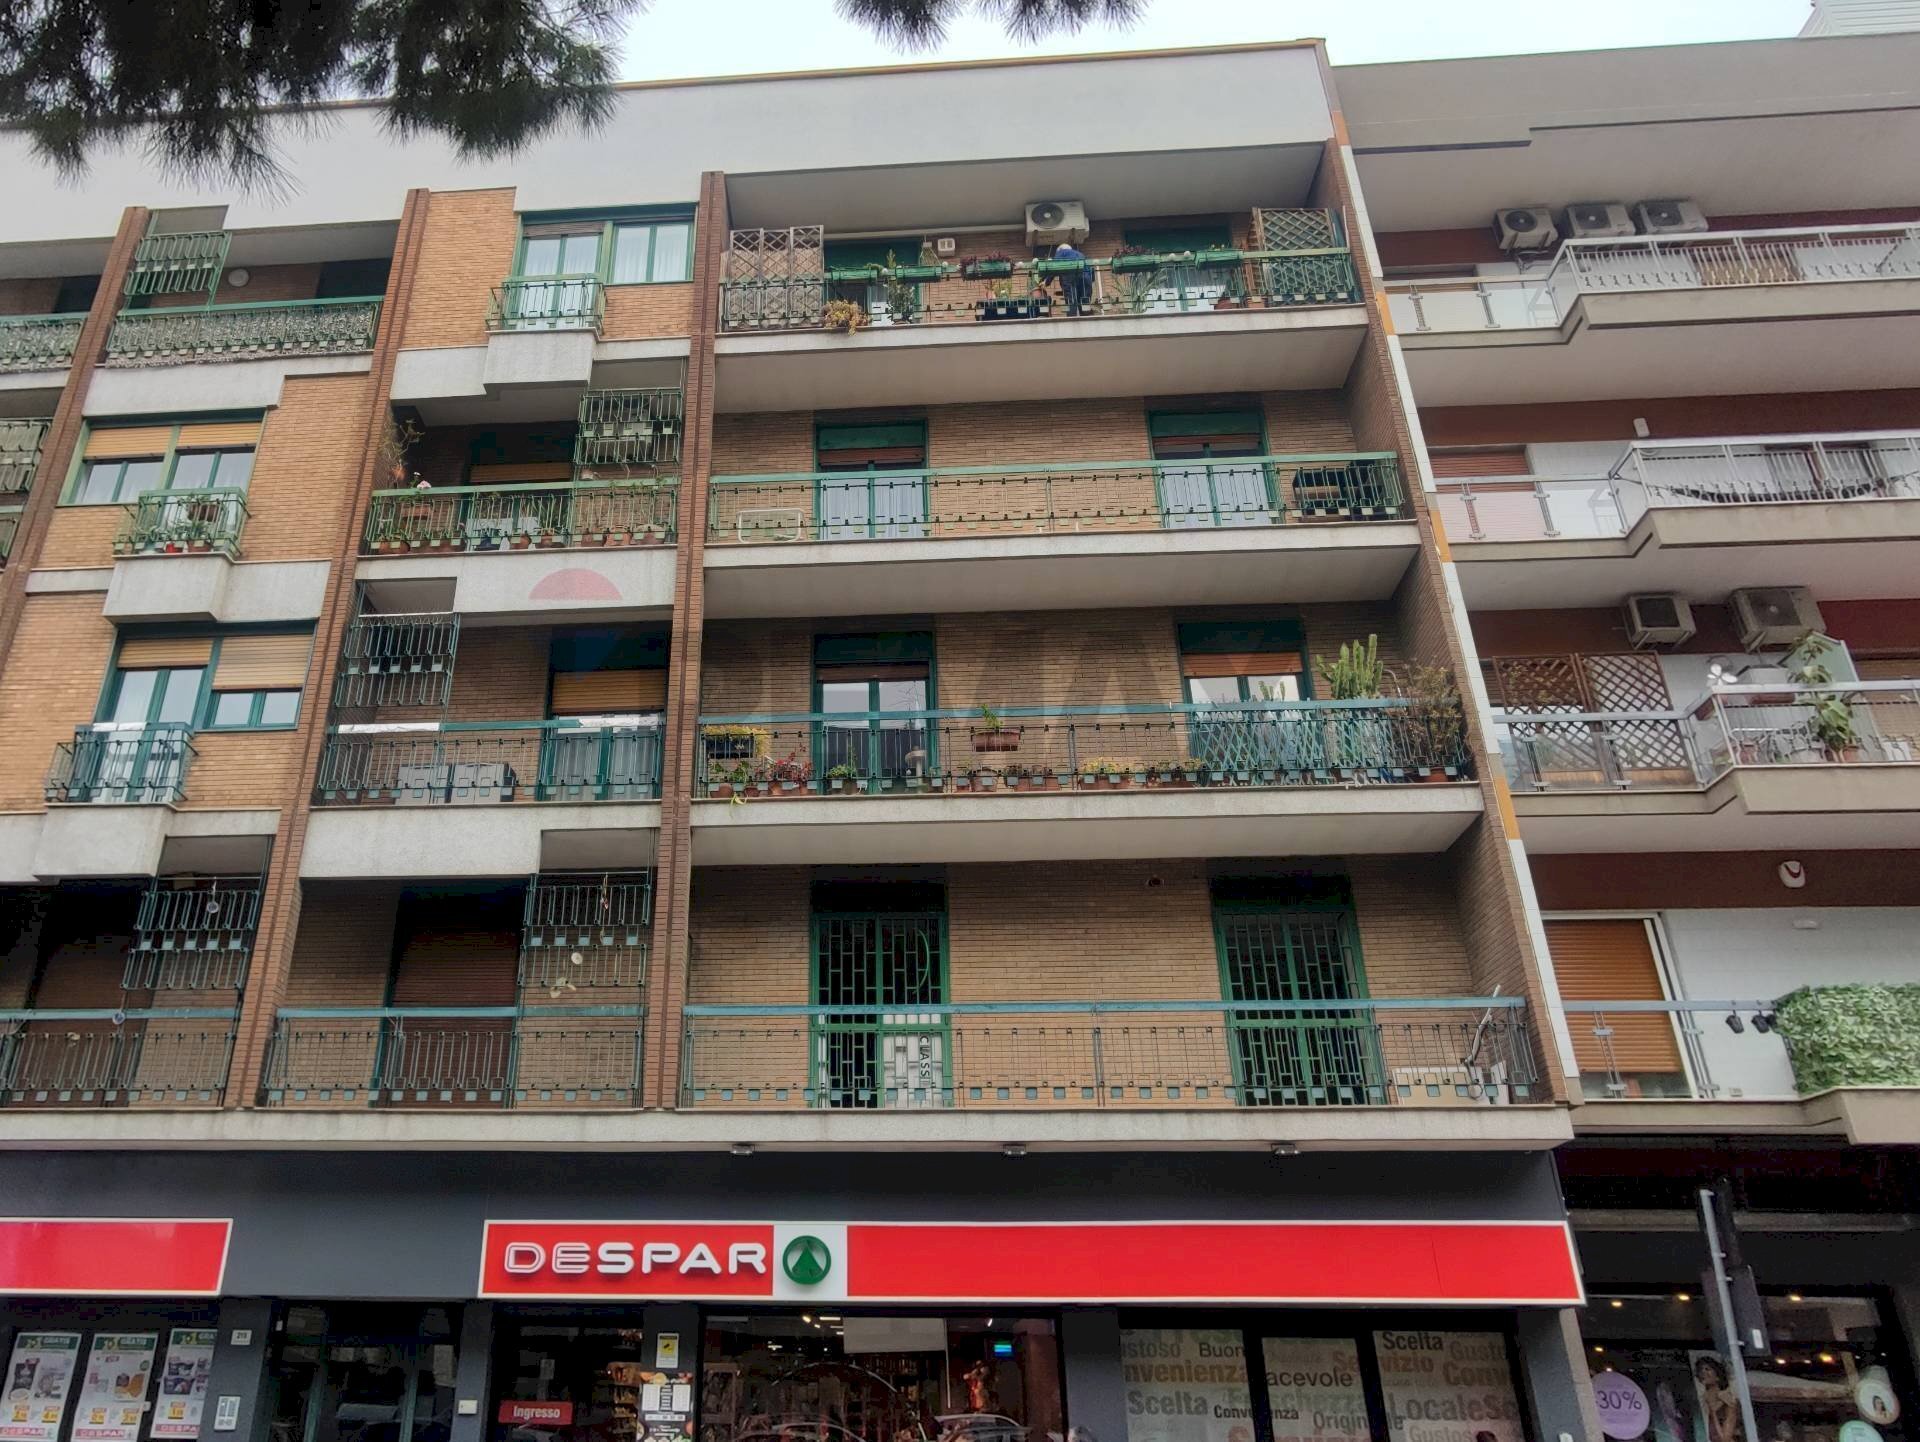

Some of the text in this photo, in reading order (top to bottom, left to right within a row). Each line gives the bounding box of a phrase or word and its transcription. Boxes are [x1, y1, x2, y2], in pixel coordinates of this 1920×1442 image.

[503, 1241, 766, 1274] DESPAR
[1382, 1331, 1443, 1351] Scelta
[1127, 1390, 1208, 1416] Scelta
[1595, 1391, 1642, 1410] 30%
[513, 1406, 560, 1420] Ingresso
